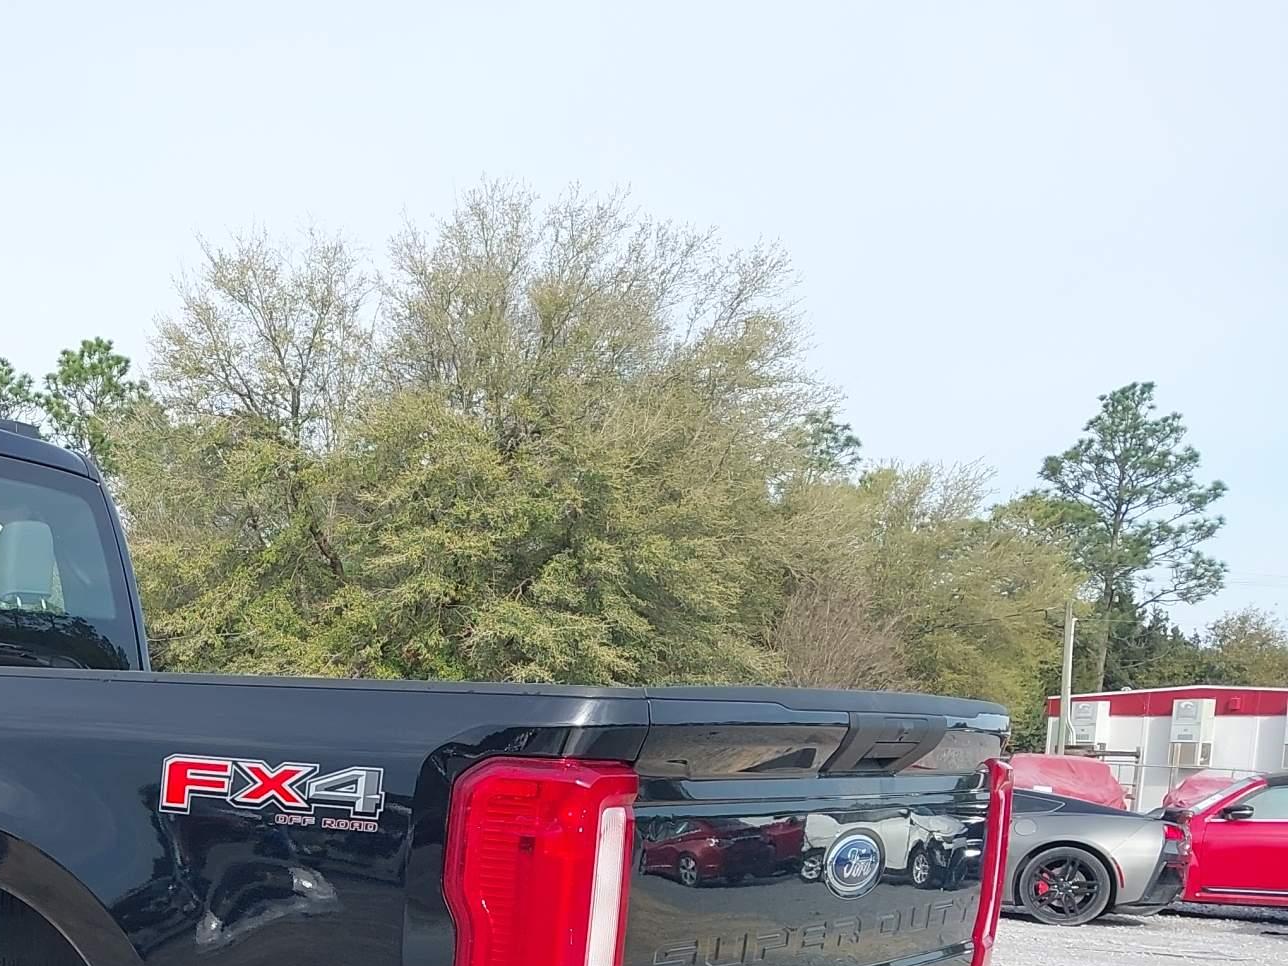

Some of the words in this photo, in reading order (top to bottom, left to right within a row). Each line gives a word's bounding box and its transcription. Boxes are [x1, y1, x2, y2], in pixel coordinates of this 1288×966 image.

[159, 754, 384, 820] FX4
[274, 813, 316, 827] OFF
[321, 818, 379, 833] ROAD
[843, 847, 873, 879] Ford
[877, 894, 975, 936] DUTY
